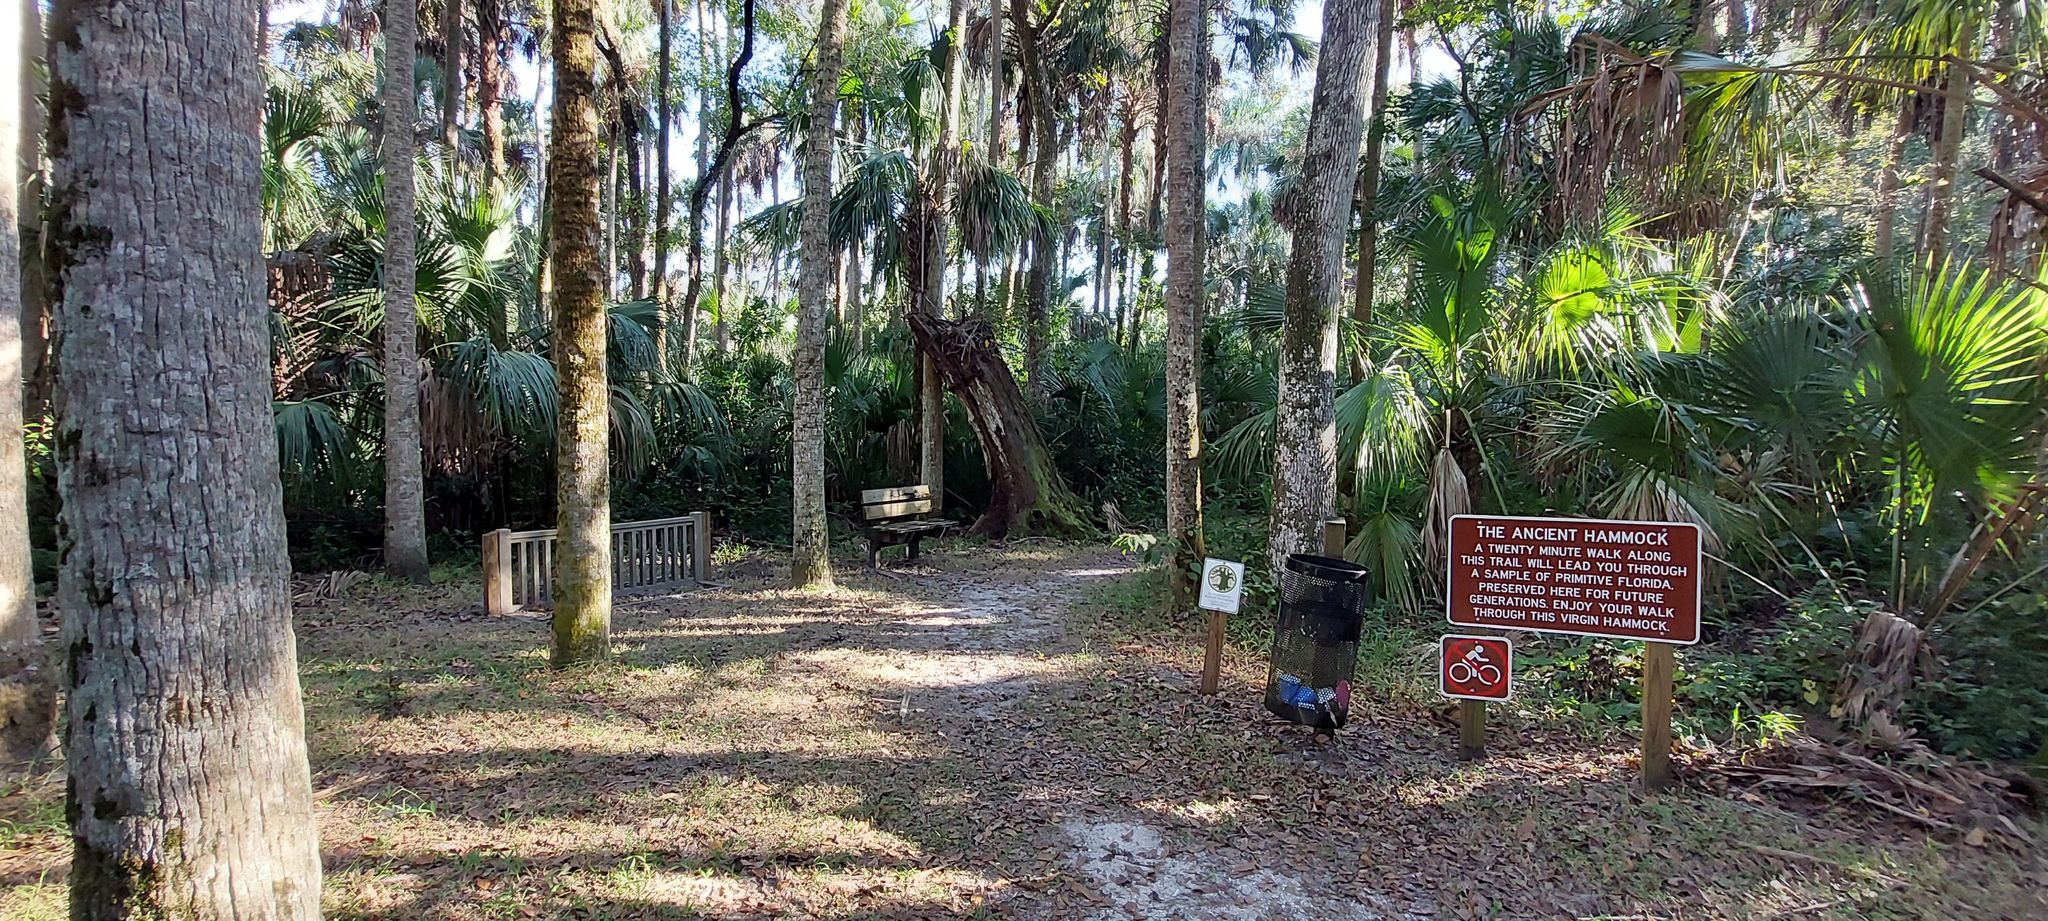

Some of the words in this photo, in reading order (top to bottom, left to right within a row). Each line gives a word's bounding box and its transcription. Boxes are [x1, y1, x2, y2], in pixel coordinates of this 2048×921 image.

[1477, 525, 1504, 539] THE
[1512, 527, 1577, 542] ANCIENT
[1584, 530, 1668, 545] HAMMOCK
[1475, 544, 1483, 553] A
[1488, 544, 1534, 555] TWENTY
[1539, 546, 1581, 557] MINUTE
[1587, 548, 1621, 560] WALK
[1628, 550, 1670, 562] ALONG
[1461, 556, 1484, 566] THIS
[1490, 557, 1522, 567] TRAIL
[1528, 559, 1553, 569] WILL
[1558, 561, 1590, 571] LEAD
[1596, 563, 1622, 573] YOU
[1627, 564, 1687, 576] THROUGH
[1471, 569, 1479, 578] A
[1484, 570, 1530, 581] SAMPLE
[1536, 572, 1551, 582] OF
[1556, 573, 1612, 586] PRIMITIVE
[1479, 583, 1545, 595] PRESERVED
[1551, 587, 1581, 598] HERE
[1586, 588, 1609, 599] FOR
[1615, 591, 1664, 603] FUTURE
[1470, 595, 1548, 609] GENERATIONS.
[1554, 600, 1592, 611] ENJOY
[1598, 603, 1632, 614] YOUR
[1638, 606, 1674, 618] WALK
[1473, 607, 1526, 620] THROUGH
[1531, 611, 1555, 622] THIS
[1561, 614, 1599, 625] VIRGIN
[1604, 617, 1670, 632] HAMMOCK.
